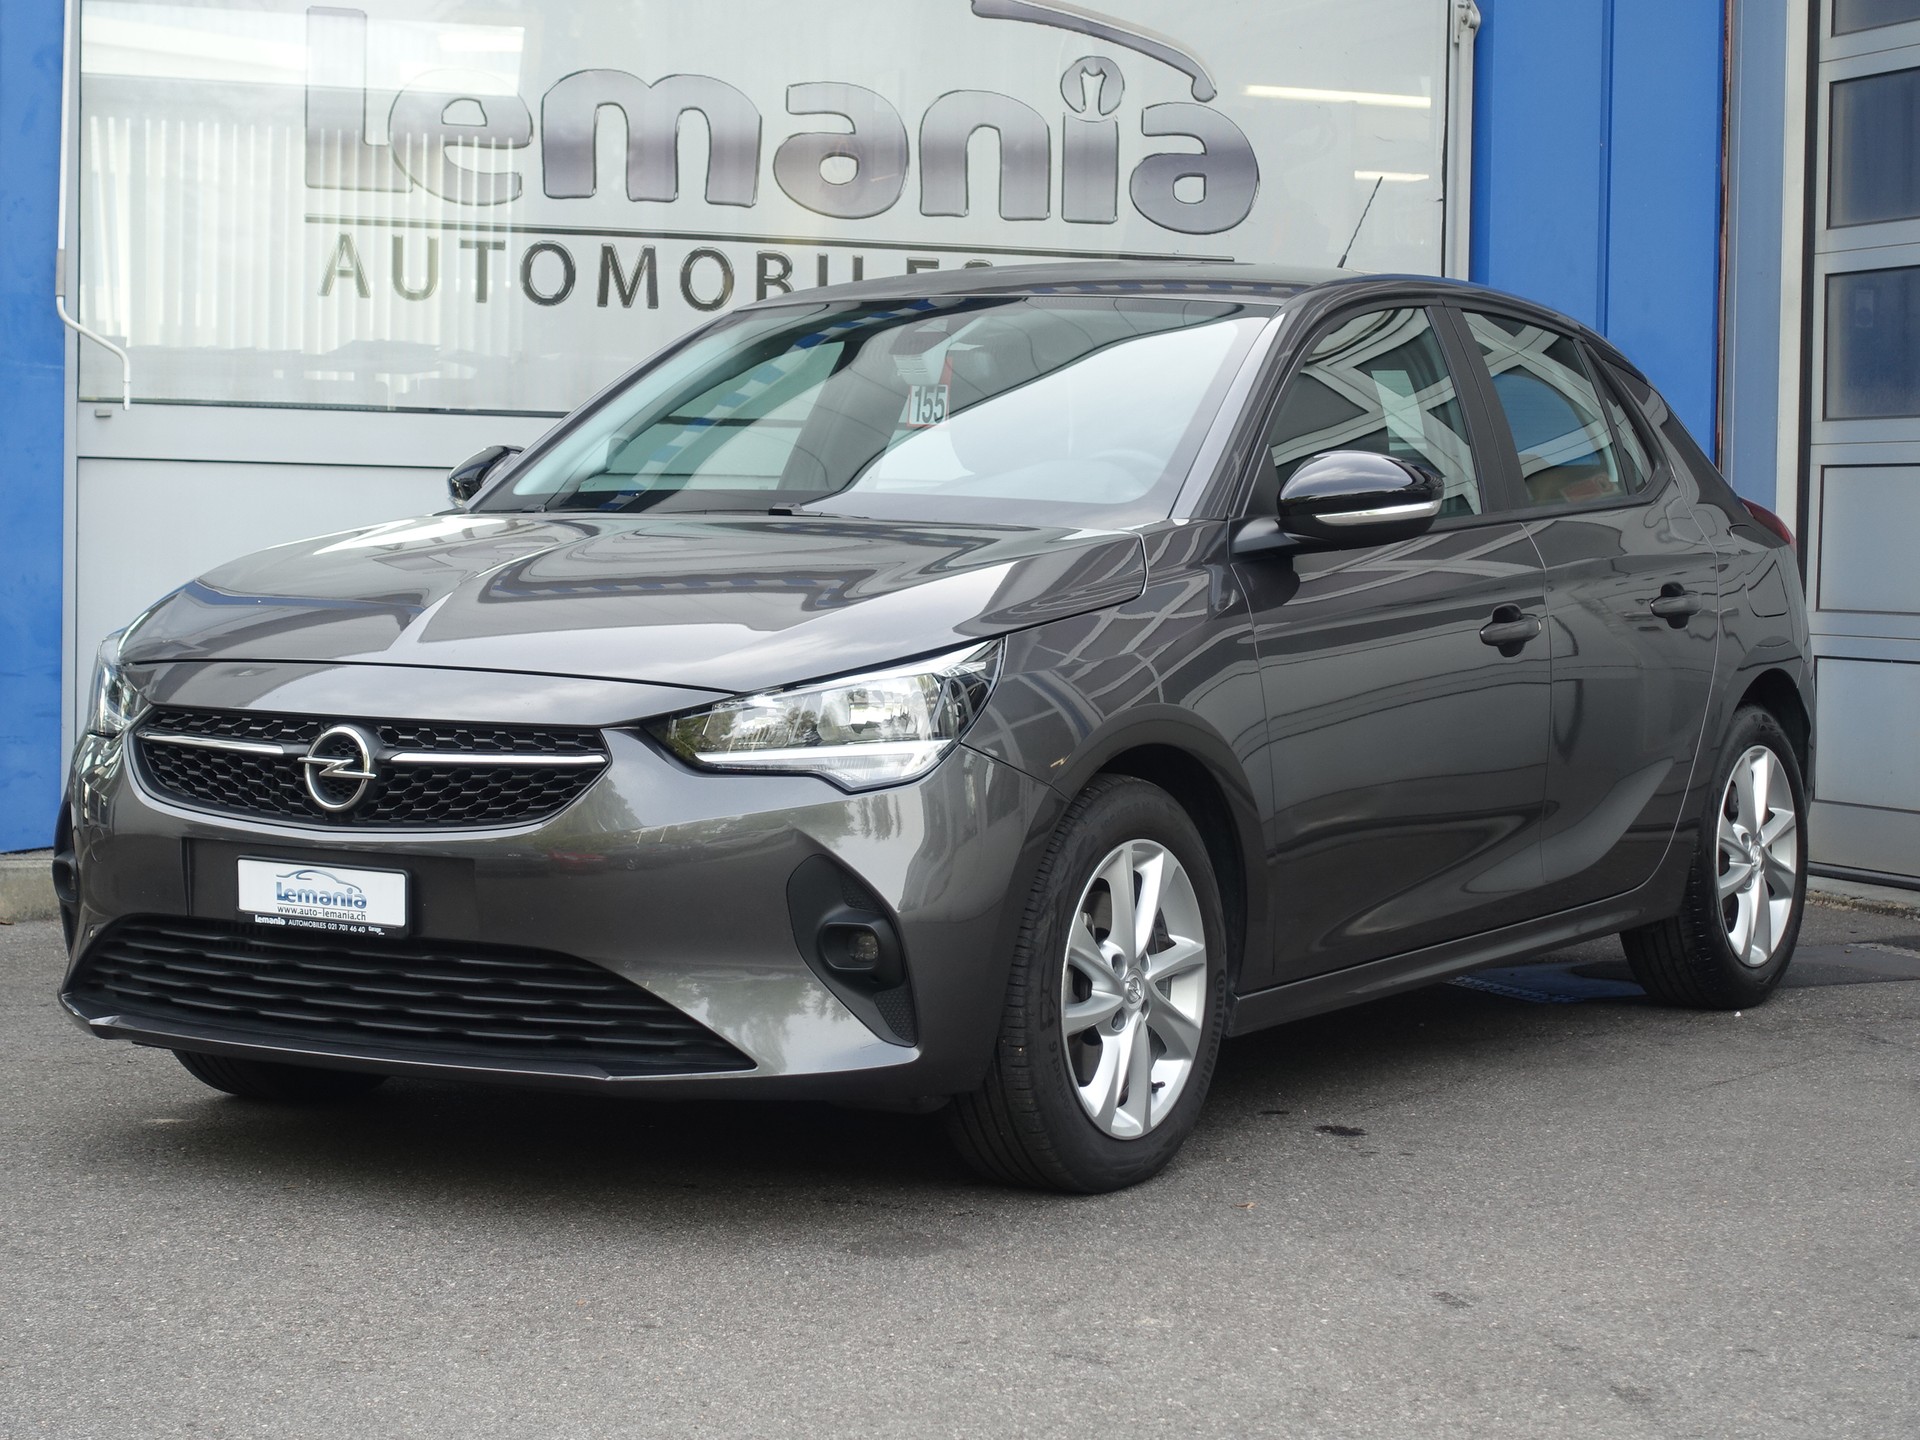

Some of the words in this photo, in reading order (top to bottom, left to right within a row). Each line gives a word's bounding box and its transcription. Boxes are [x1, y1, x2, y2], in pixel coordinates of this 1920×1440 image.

[305, 6, 1260, 235] Lemania
[317, 231, 993, 311] AUTOMOBI
[914, 386, 947, 423] 155
[276, 881, 367, 909] Lemania
[277, 906, 366, 921] www.auto-lemania.ch
[288, 919, 326, 929] AUTOMOBILES
